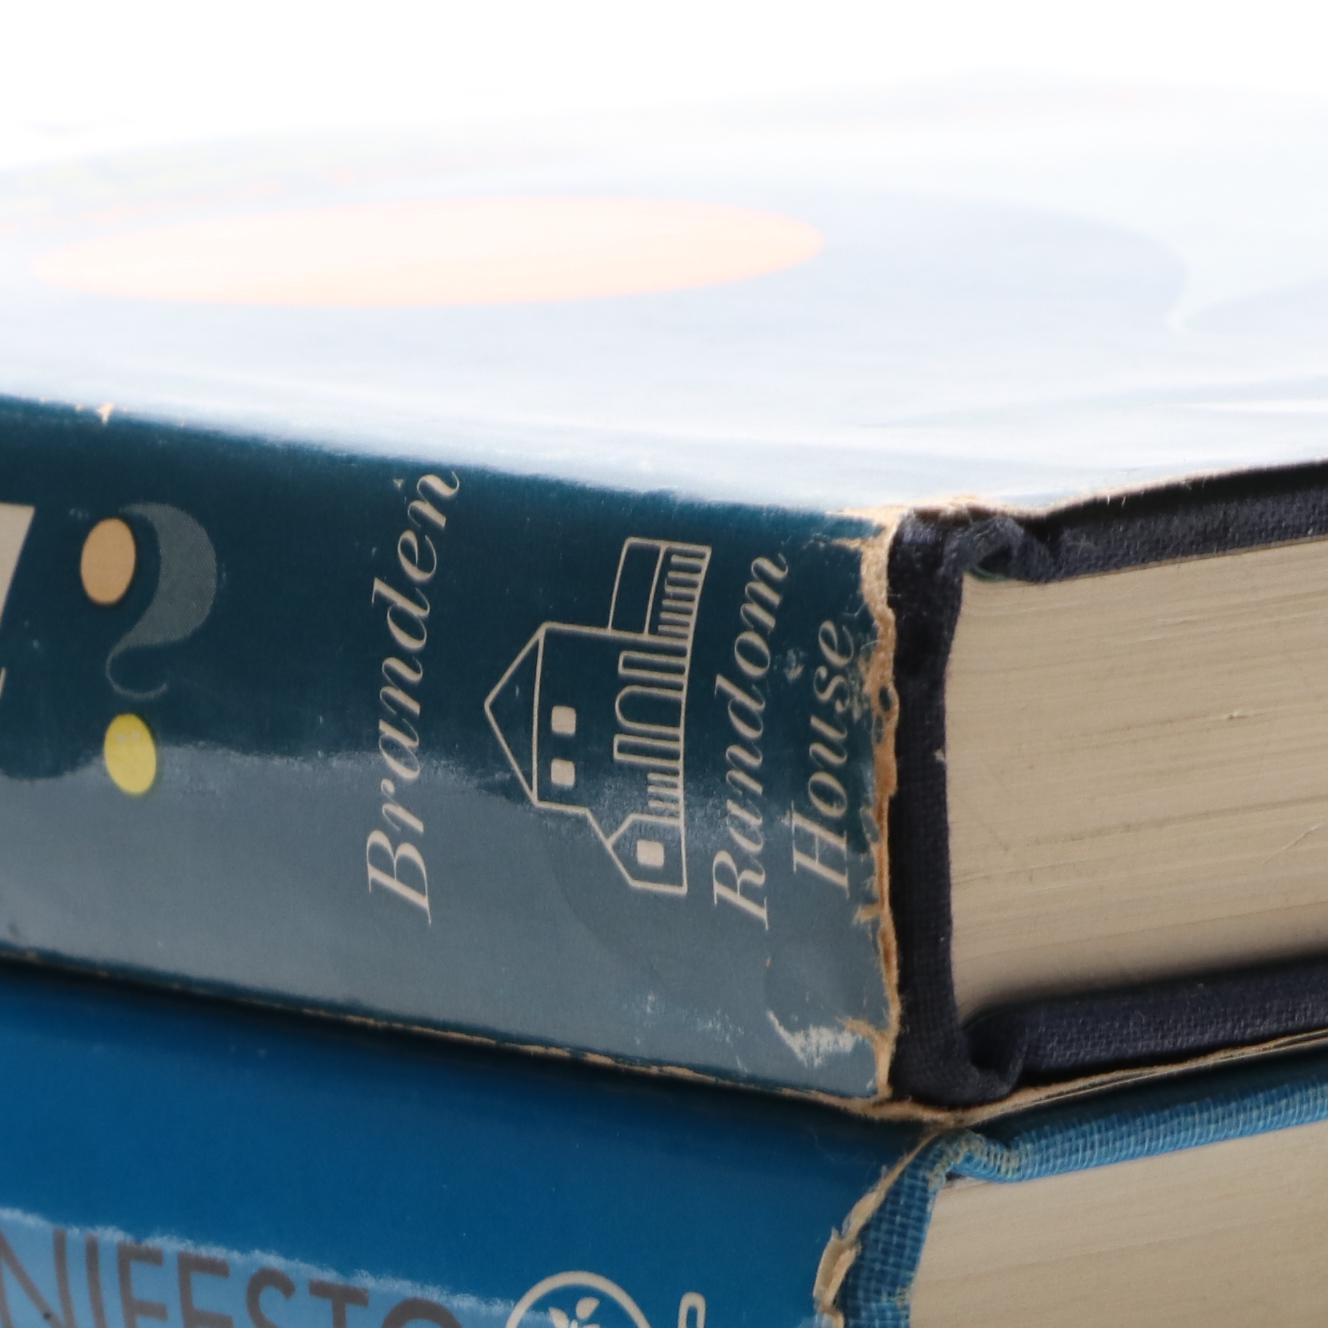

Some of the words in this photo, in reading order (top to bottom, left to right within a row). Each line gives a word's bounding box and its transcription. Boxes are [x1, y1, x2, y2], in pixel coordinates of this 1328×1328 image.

[366, 471, 460, 926] Branden
[713, 554, 788, 931] Random
[792, 619, 857, 900] House
